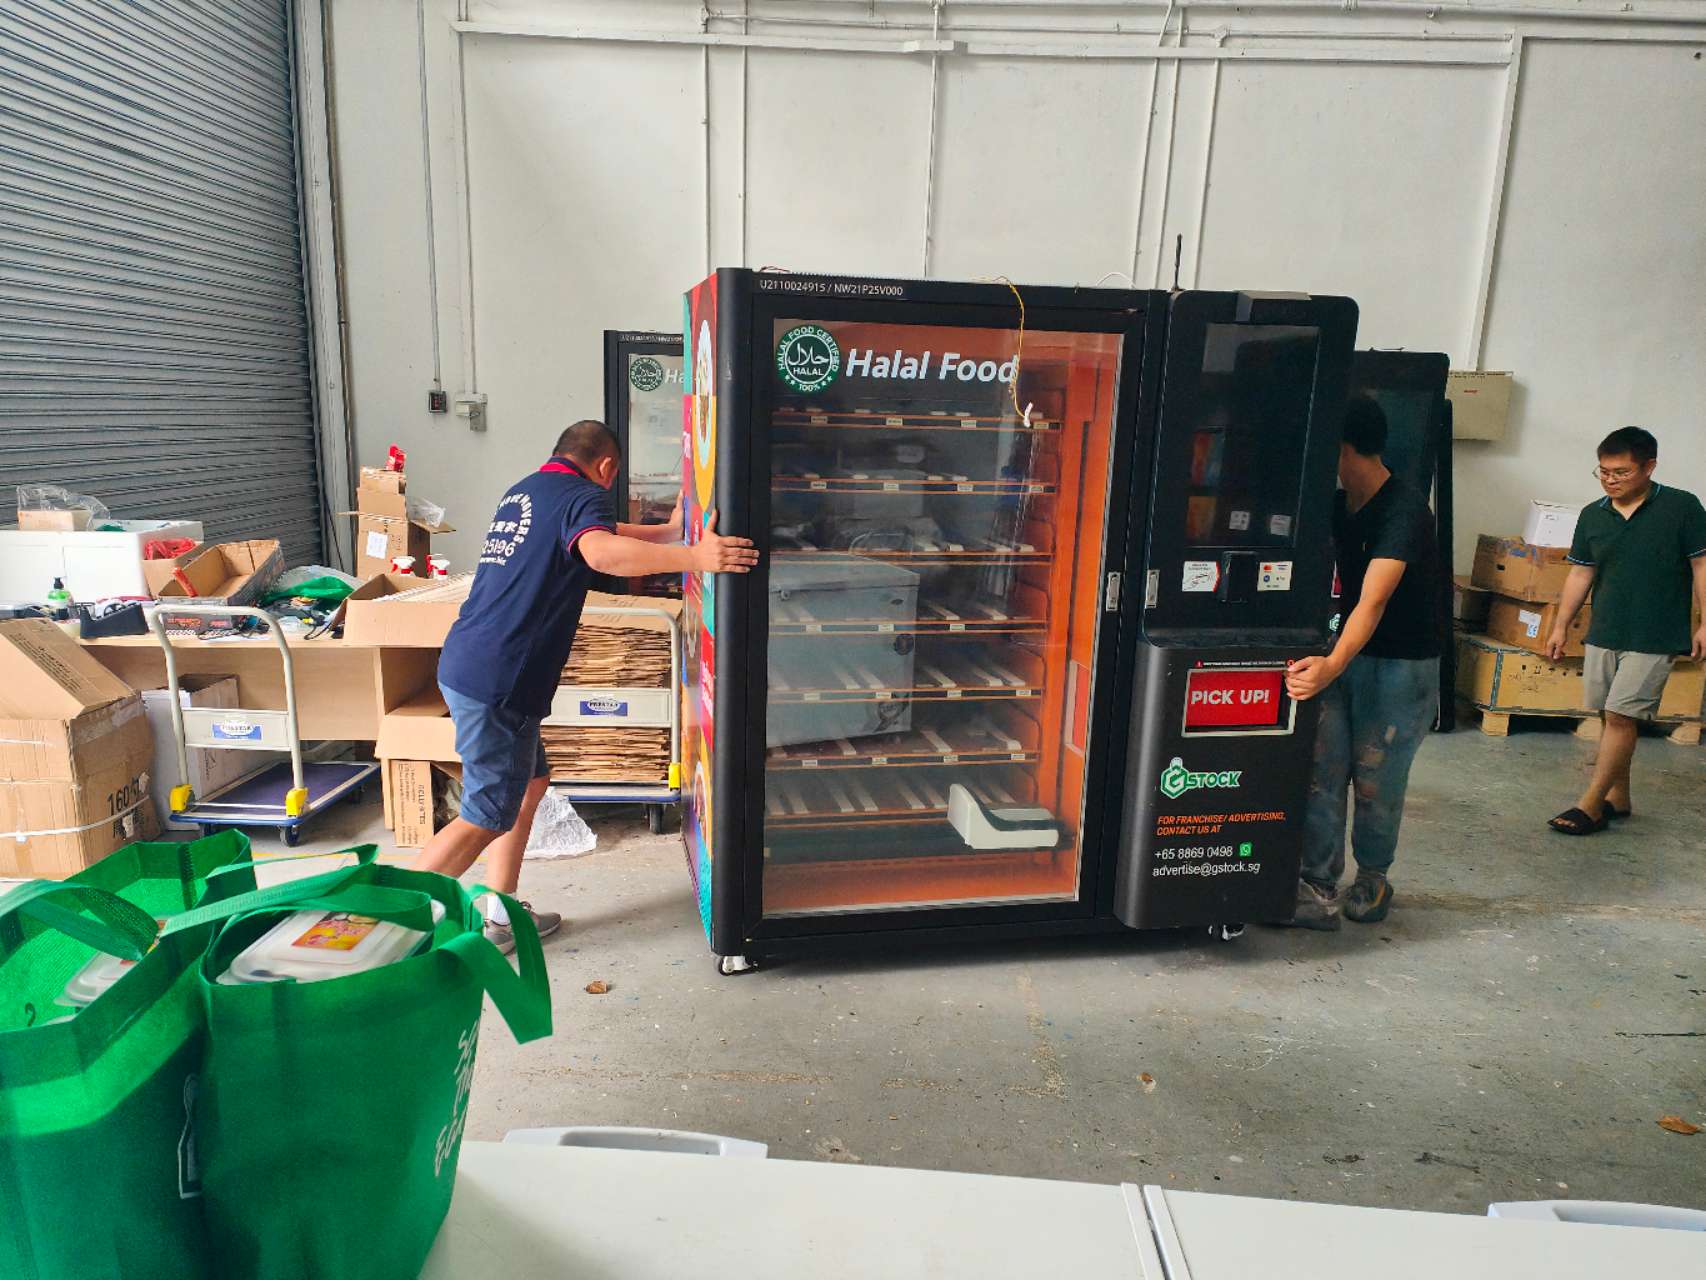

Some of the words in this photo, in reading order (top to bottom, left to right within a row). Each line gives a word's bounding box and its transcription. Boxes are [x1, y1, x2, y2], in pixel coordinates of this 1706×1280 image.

[760, 279, 826, 294] U2110024915
[834, 283, 904, 296] NW21P25V000
[777, 341, 790, 371] HALAL
[788, 326, 815, 340] FOOD
[816, 329, 840, 372] CERTIFIED
[787, 342, 830, 366] حلال
[793, 367, 825, 376] HALAL
[846, 348, 931, 380] Halal
[939, 351, 1019, 383] Food
[799, 383, 820, 392] 100%
[1190, 690, 1234, 705] PICK
[1240, 689, 1270, 704] UP!
[1157, 815, 1175, 825] FOR
[1156, 826, 1196, 836] CONTACT
[1197, 825, 1210, 835] US
[1211, 825, 1222, 834] AT
[1154, 848, 1176, 860] +65
[1177, 847, 1204, 859] 8869
[1207, 845, 1233, 858] 0498
[1152, 860, 1261, 877] advertise@gstock.sg
